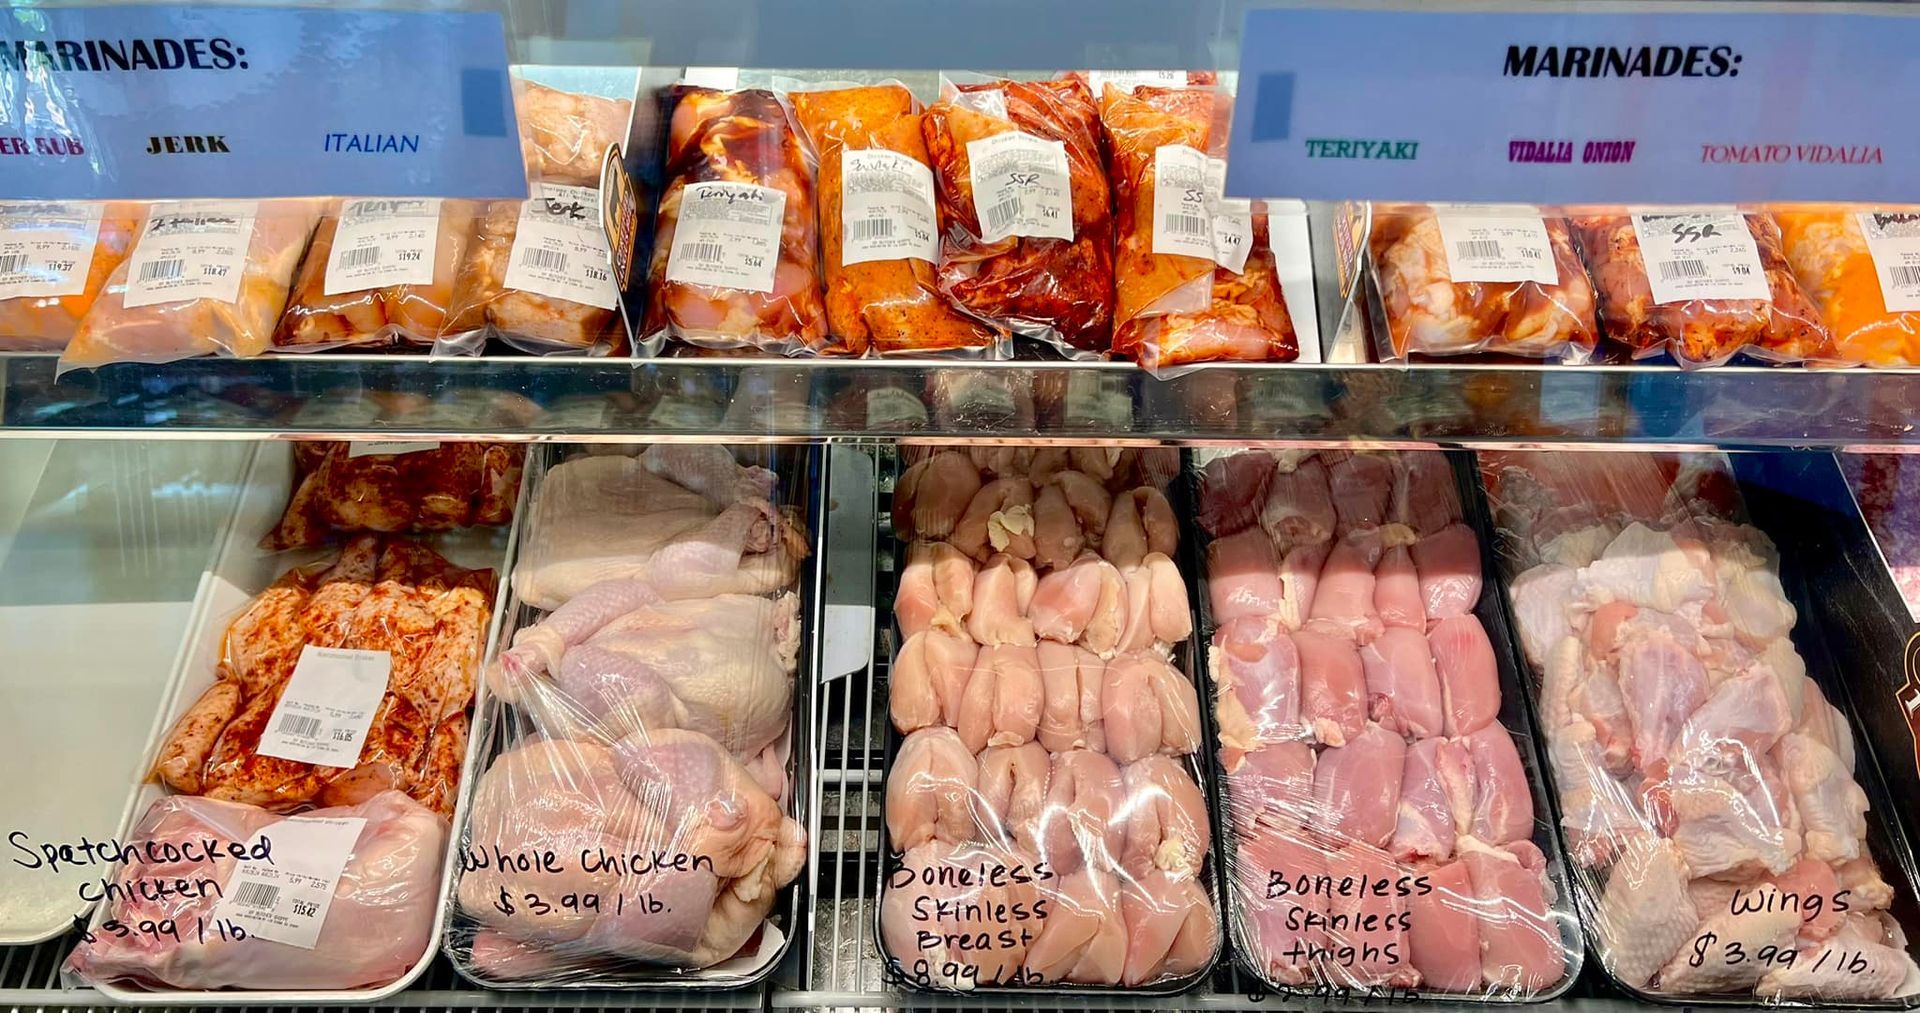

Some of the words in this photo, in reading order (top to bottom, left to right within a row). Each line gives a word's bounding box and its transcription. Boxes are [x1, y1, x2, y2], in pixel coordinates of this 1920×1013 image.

[1503, 45, 1743, 78] MARINADES:
[146, 135, 231, 154] JERK
[324, 133, 419, 153] ITALIAN
[1305, 139, 1418, 160] TERIYAKI
[1508, 140, 1573, 163] VIDALIA
[1582, 140, 1637, 163] ONION
[1701, 144, 1791, 164] TOMATO
[1795, 144, 1883, 165] VIDALIA
[1005, 172, 1041, 186] SSR
[696, 185, 765, 205] Teriyaki
[534, 197, 586, 220] Jerk
[1671, 222, 1723, 244] SSR
[8, 831, 274, 873] Spatchcocked
[889, 861, 1054, 889] Boneless
[1265, 869, 1433, 899] Boneless
[293, 903, 317, 918] $15.42
[493, 886, 516, 917] $
[525, 892, 601, 916] 3.99
[639, 893, 673, 915] lb.
[912, 895, 1049, 923] Skinless
[217, 918, 256, 942] lb.
[1285, 906, 1413, 932] Skinless
[916, 927, 1033, 951] Breast
[1688, 931, 1718, 968] $
[1724, 942, 1801, 970] 3.99
[1837, 951, 1876, 974] lb.
[913, 959, 980, 986] 8.99
